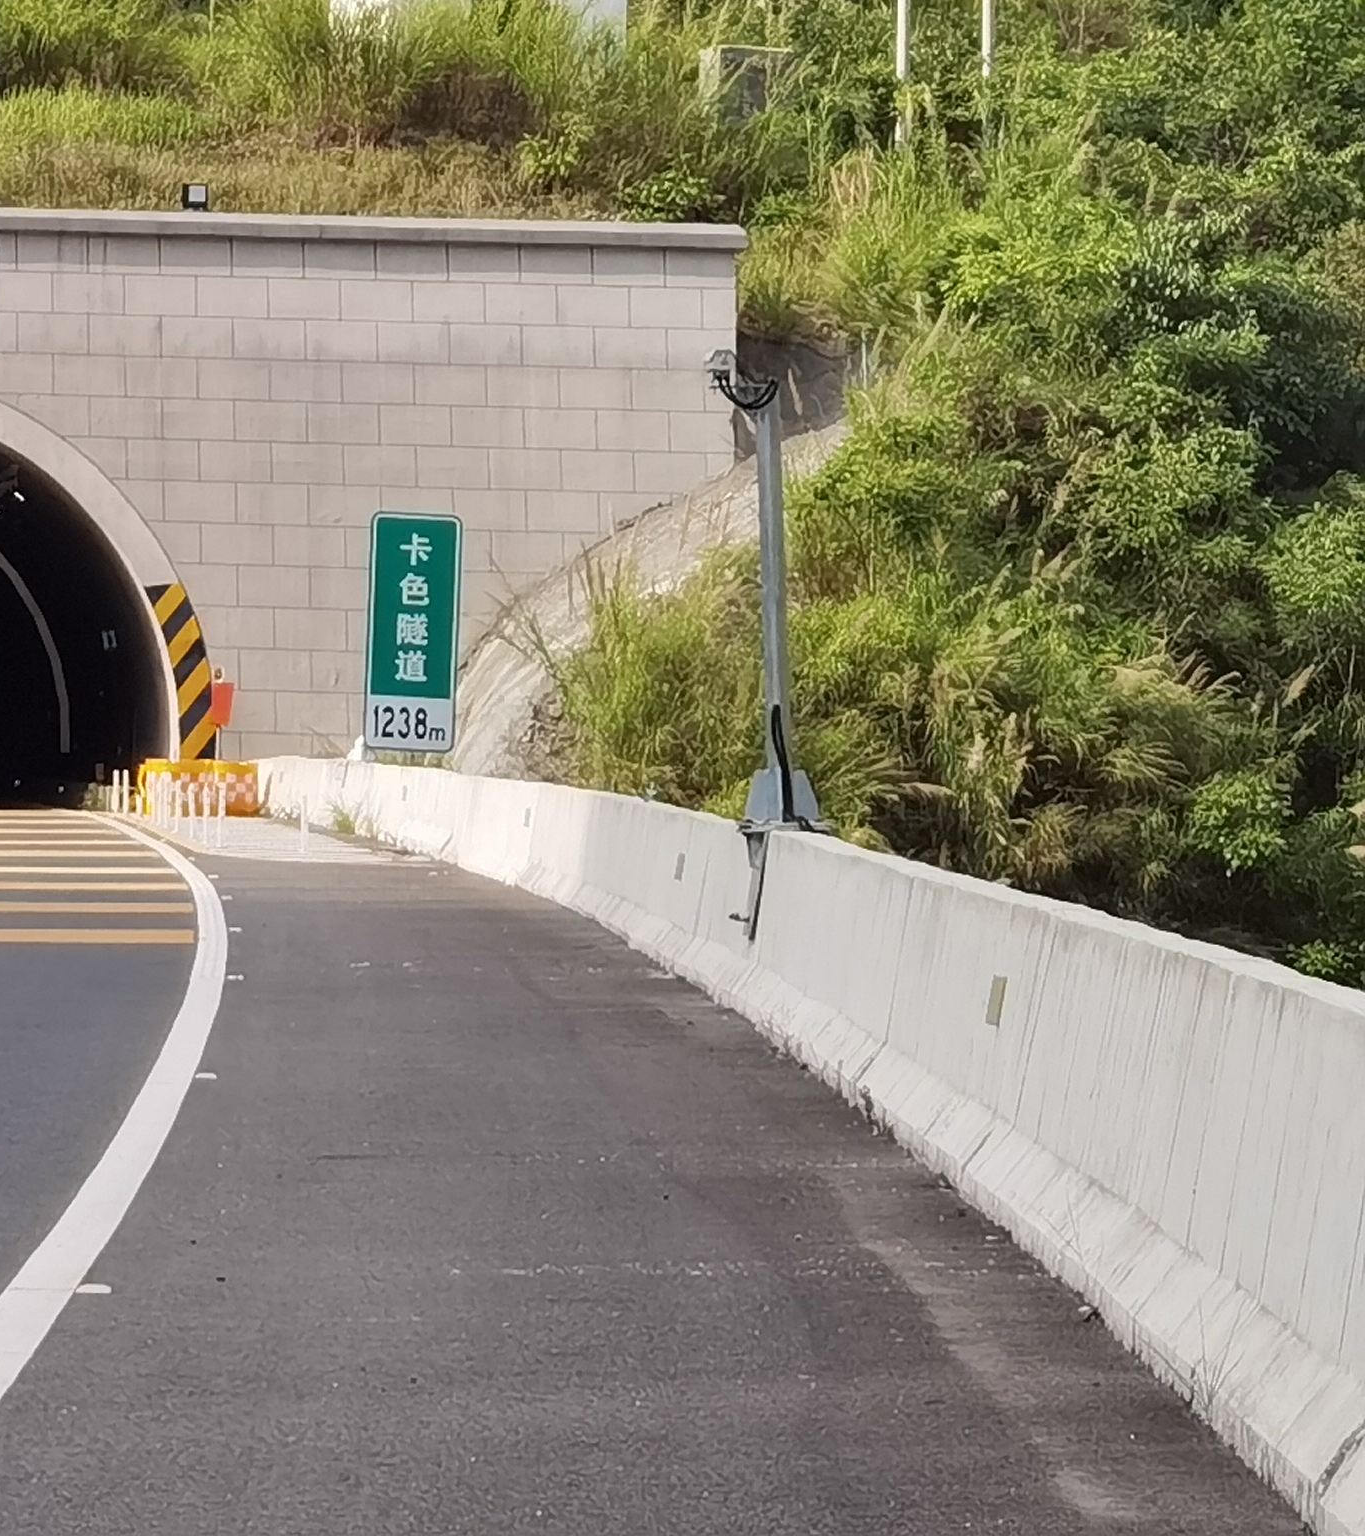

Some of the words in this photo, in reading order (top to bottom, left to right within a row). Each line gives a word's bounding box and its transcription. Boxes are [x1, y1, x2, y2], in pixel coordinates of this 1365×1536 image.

[394, 532, 433, 683] 卡色隧道
[373, 704, 446, 742] 1238m
